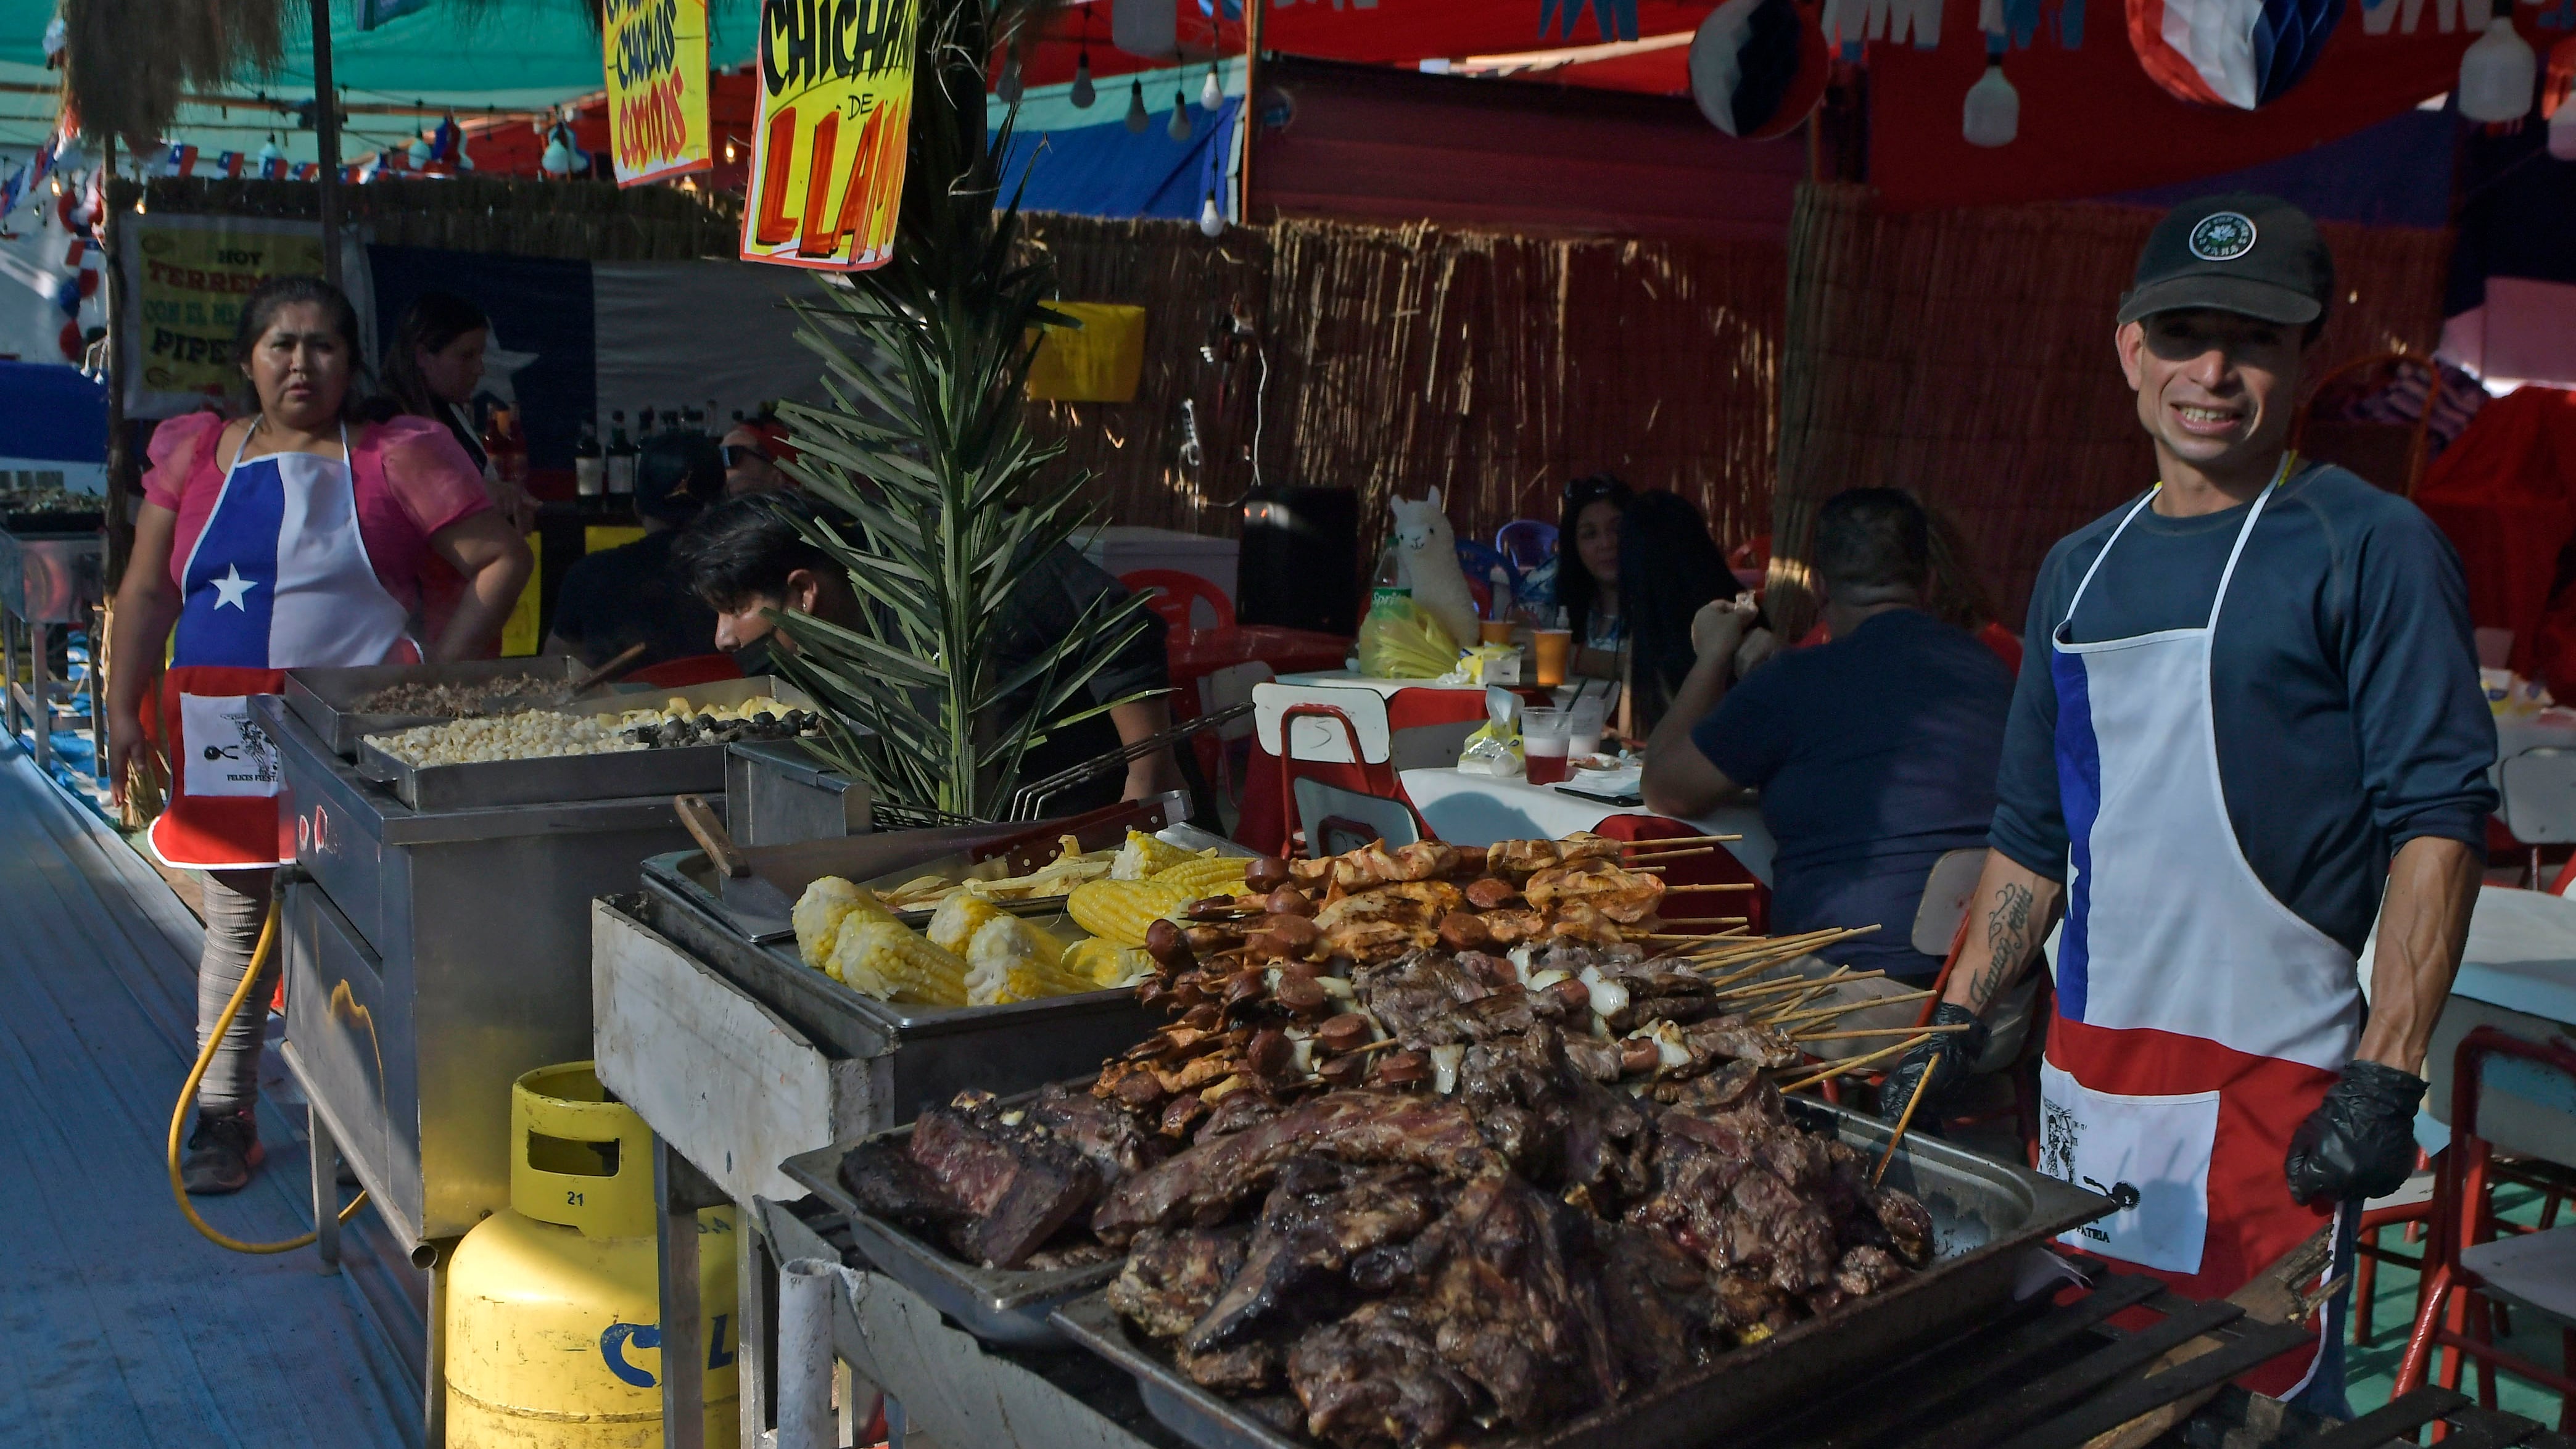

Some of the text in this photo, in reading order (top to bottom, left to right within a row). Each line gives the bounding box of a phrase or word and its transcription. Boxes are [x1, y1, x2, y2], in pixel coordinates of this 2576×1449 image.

[620, 65, 686, 169] COCIDOS
[848, 93, 874, 120] DE
[218, 250, 263, 265] HOY
[152, 328, 236, 365] PIPE
[255, 774, 278, 782] FIEST
[567, 1191, 583, 1207] 21
